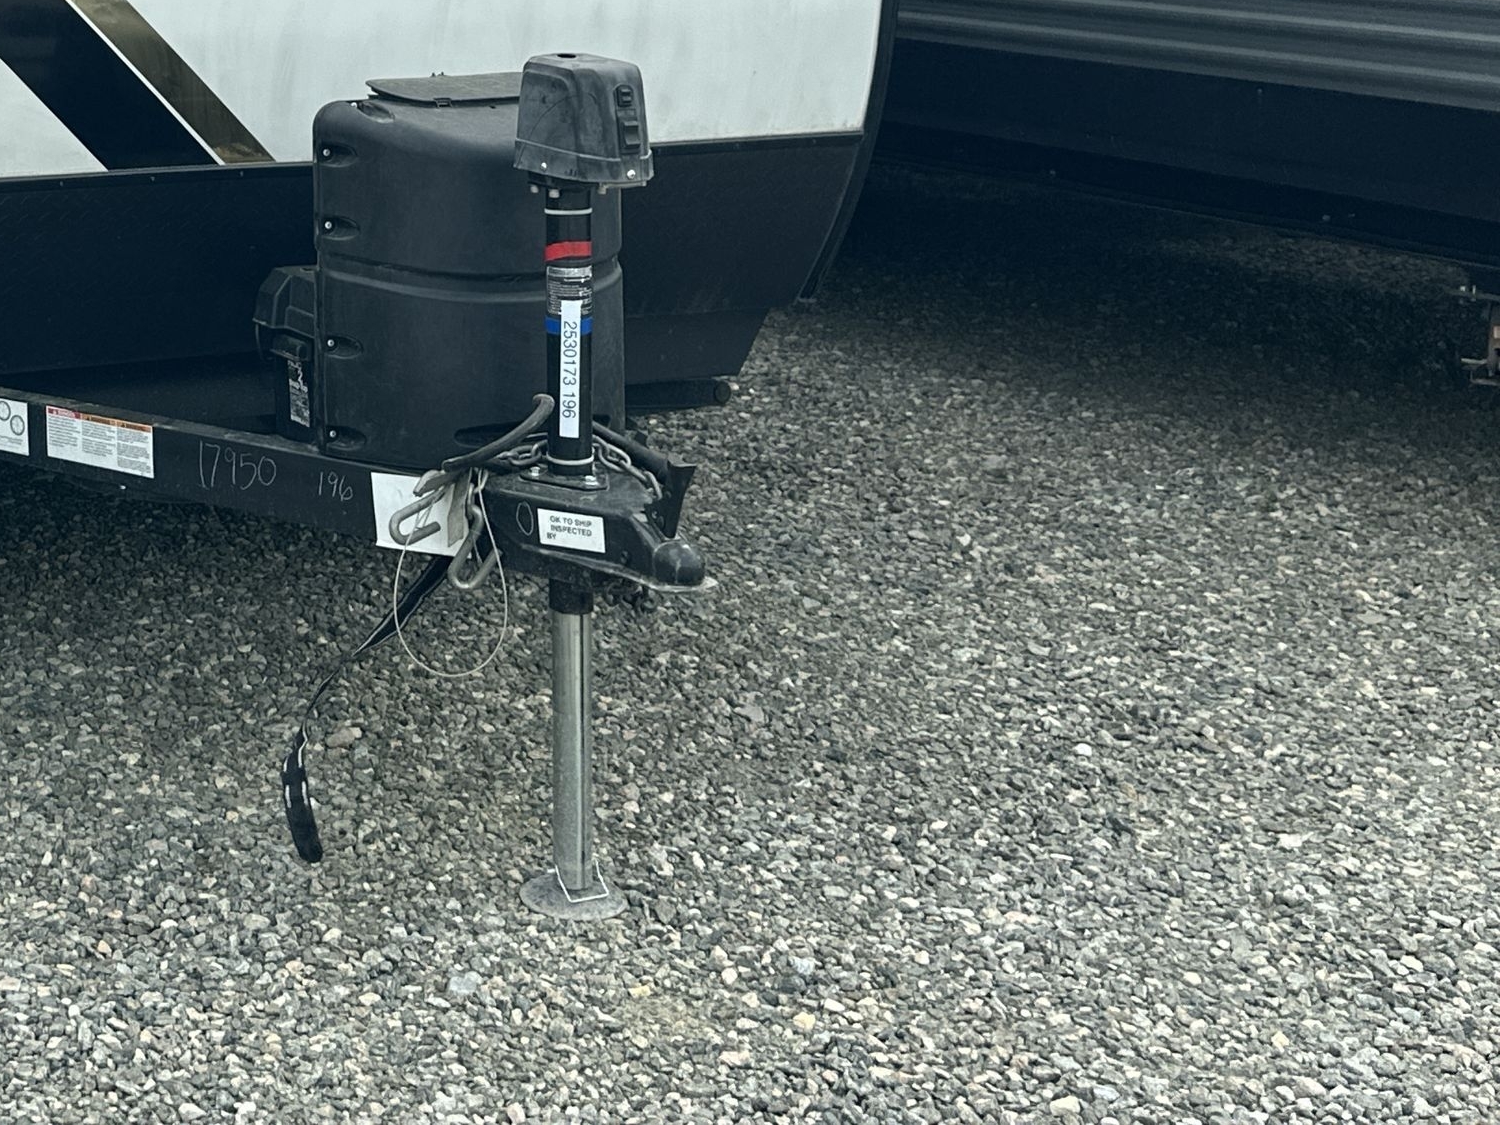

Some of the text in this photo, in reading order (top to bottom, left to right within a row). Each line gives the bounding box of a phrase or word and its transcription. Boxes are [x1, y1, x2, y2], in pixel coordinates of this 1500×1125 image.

[562, 321, 578, 419] 2530173 196
[199, 440, 277, 491] 17950
[318, 471, 354, 502] 196
[549, 515, 561, 523] OK
[563, 517, 573, 525] TO
[546, 532, 556, 540] BY
[550, 524, 592, 536] INSPECTED
